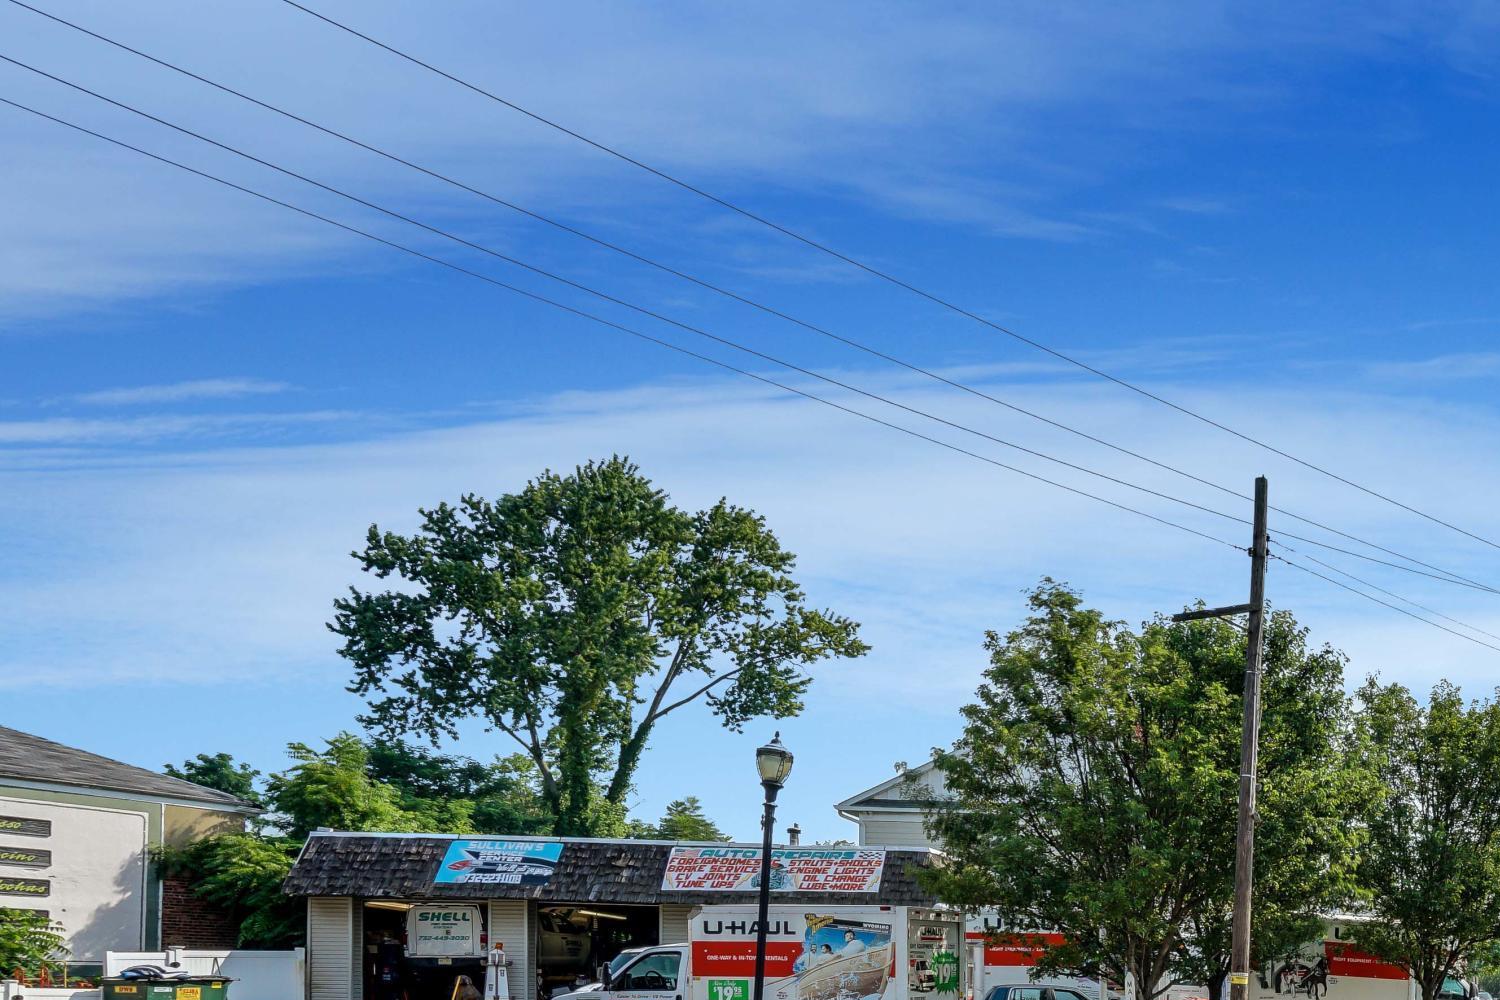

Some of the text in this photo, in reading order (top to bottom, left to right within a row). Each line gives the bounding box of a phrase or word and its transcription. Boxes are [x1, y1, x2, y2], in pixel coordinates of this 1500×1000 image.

[700, 849, 856, 860] AUTO REPAIRS
[710, 865, 761, 874] SERVICE
[788, 867, 831, 875] ENGINE
[833, 867, 876, 875] LIGHTS
[675, 873, 692, 881] CV
[824, 875, 871, 883] CHANGE
[710, 881, 736, 889] UPS
[418, 911, 471, 922] SHELL
[703, 920, 797, 935] U-HAUL
